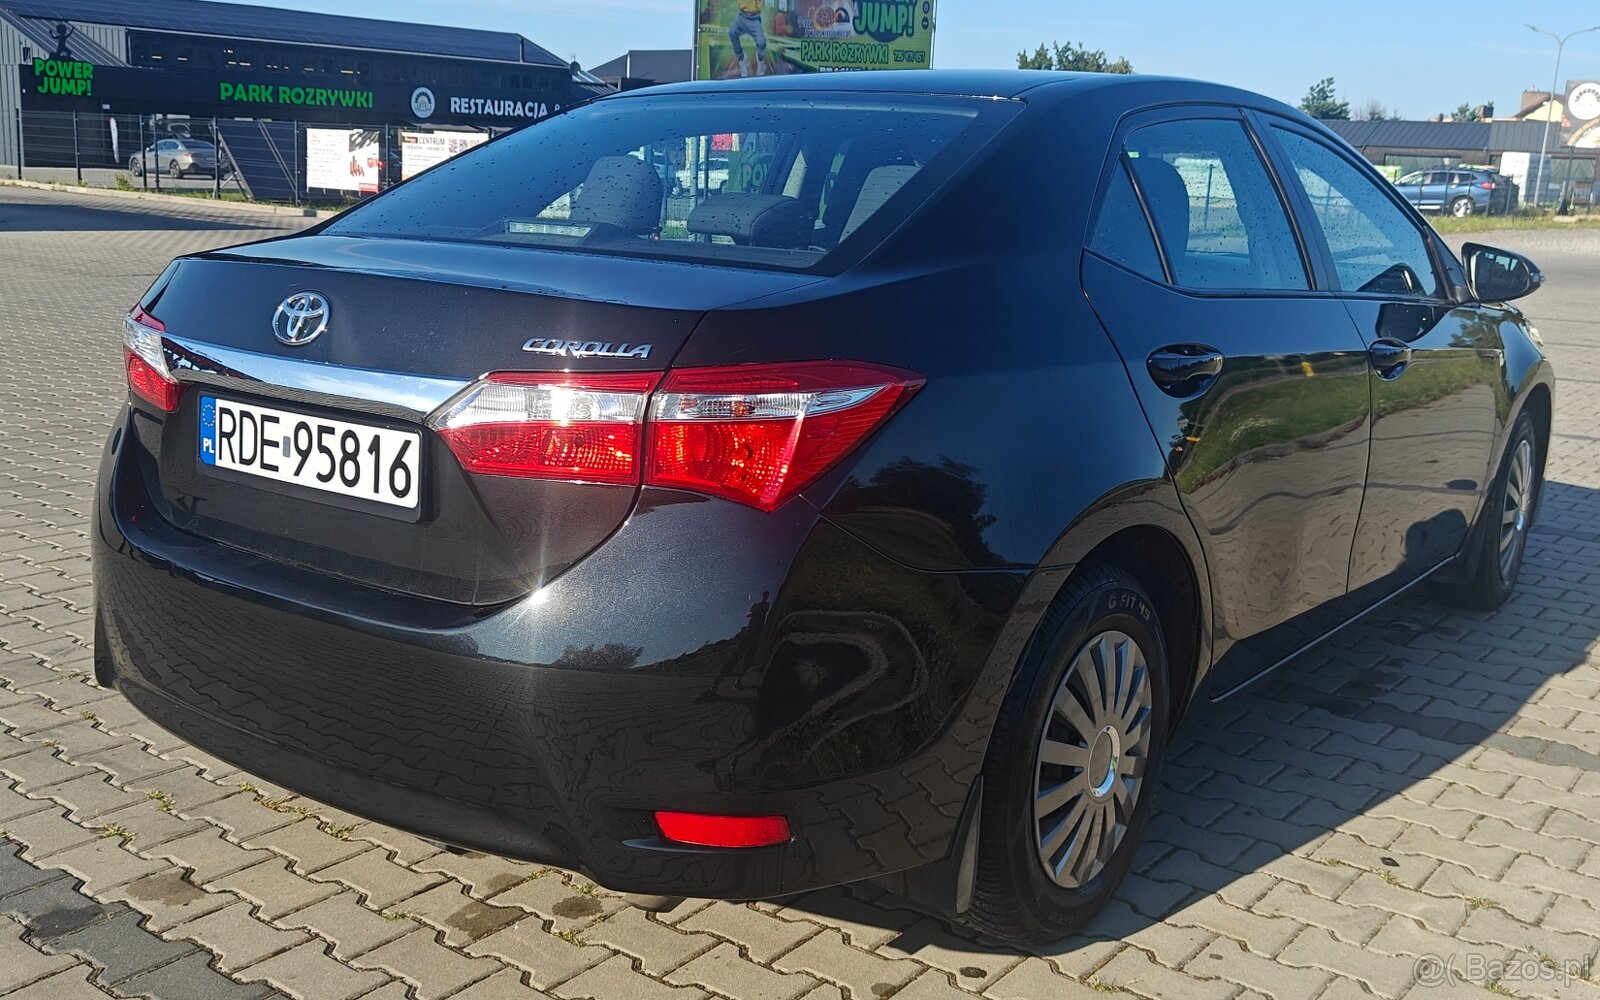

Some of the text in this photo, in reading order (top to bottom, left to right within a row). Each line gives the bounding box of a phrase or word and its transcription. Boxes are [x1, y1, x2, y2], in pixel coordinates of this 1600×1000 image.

[852, 0, 915, 36] JUMP!
[801, 40, 889, 64] PARK ROZRYWKI
[34, 58, 94, 79] POWER
[37, 77, 92, 96] JUMP!
[219, 82, 374, 109] PARK ROZRYWKI
[450, 97, 548, 119] RESTAURACJA
[419, 136, 446, 146] CENTRUM
[522, 337, 652, 359] COROLLA
[203, 437, 215, 454] PL
[218, 406, 412, 498] RDE 95816
